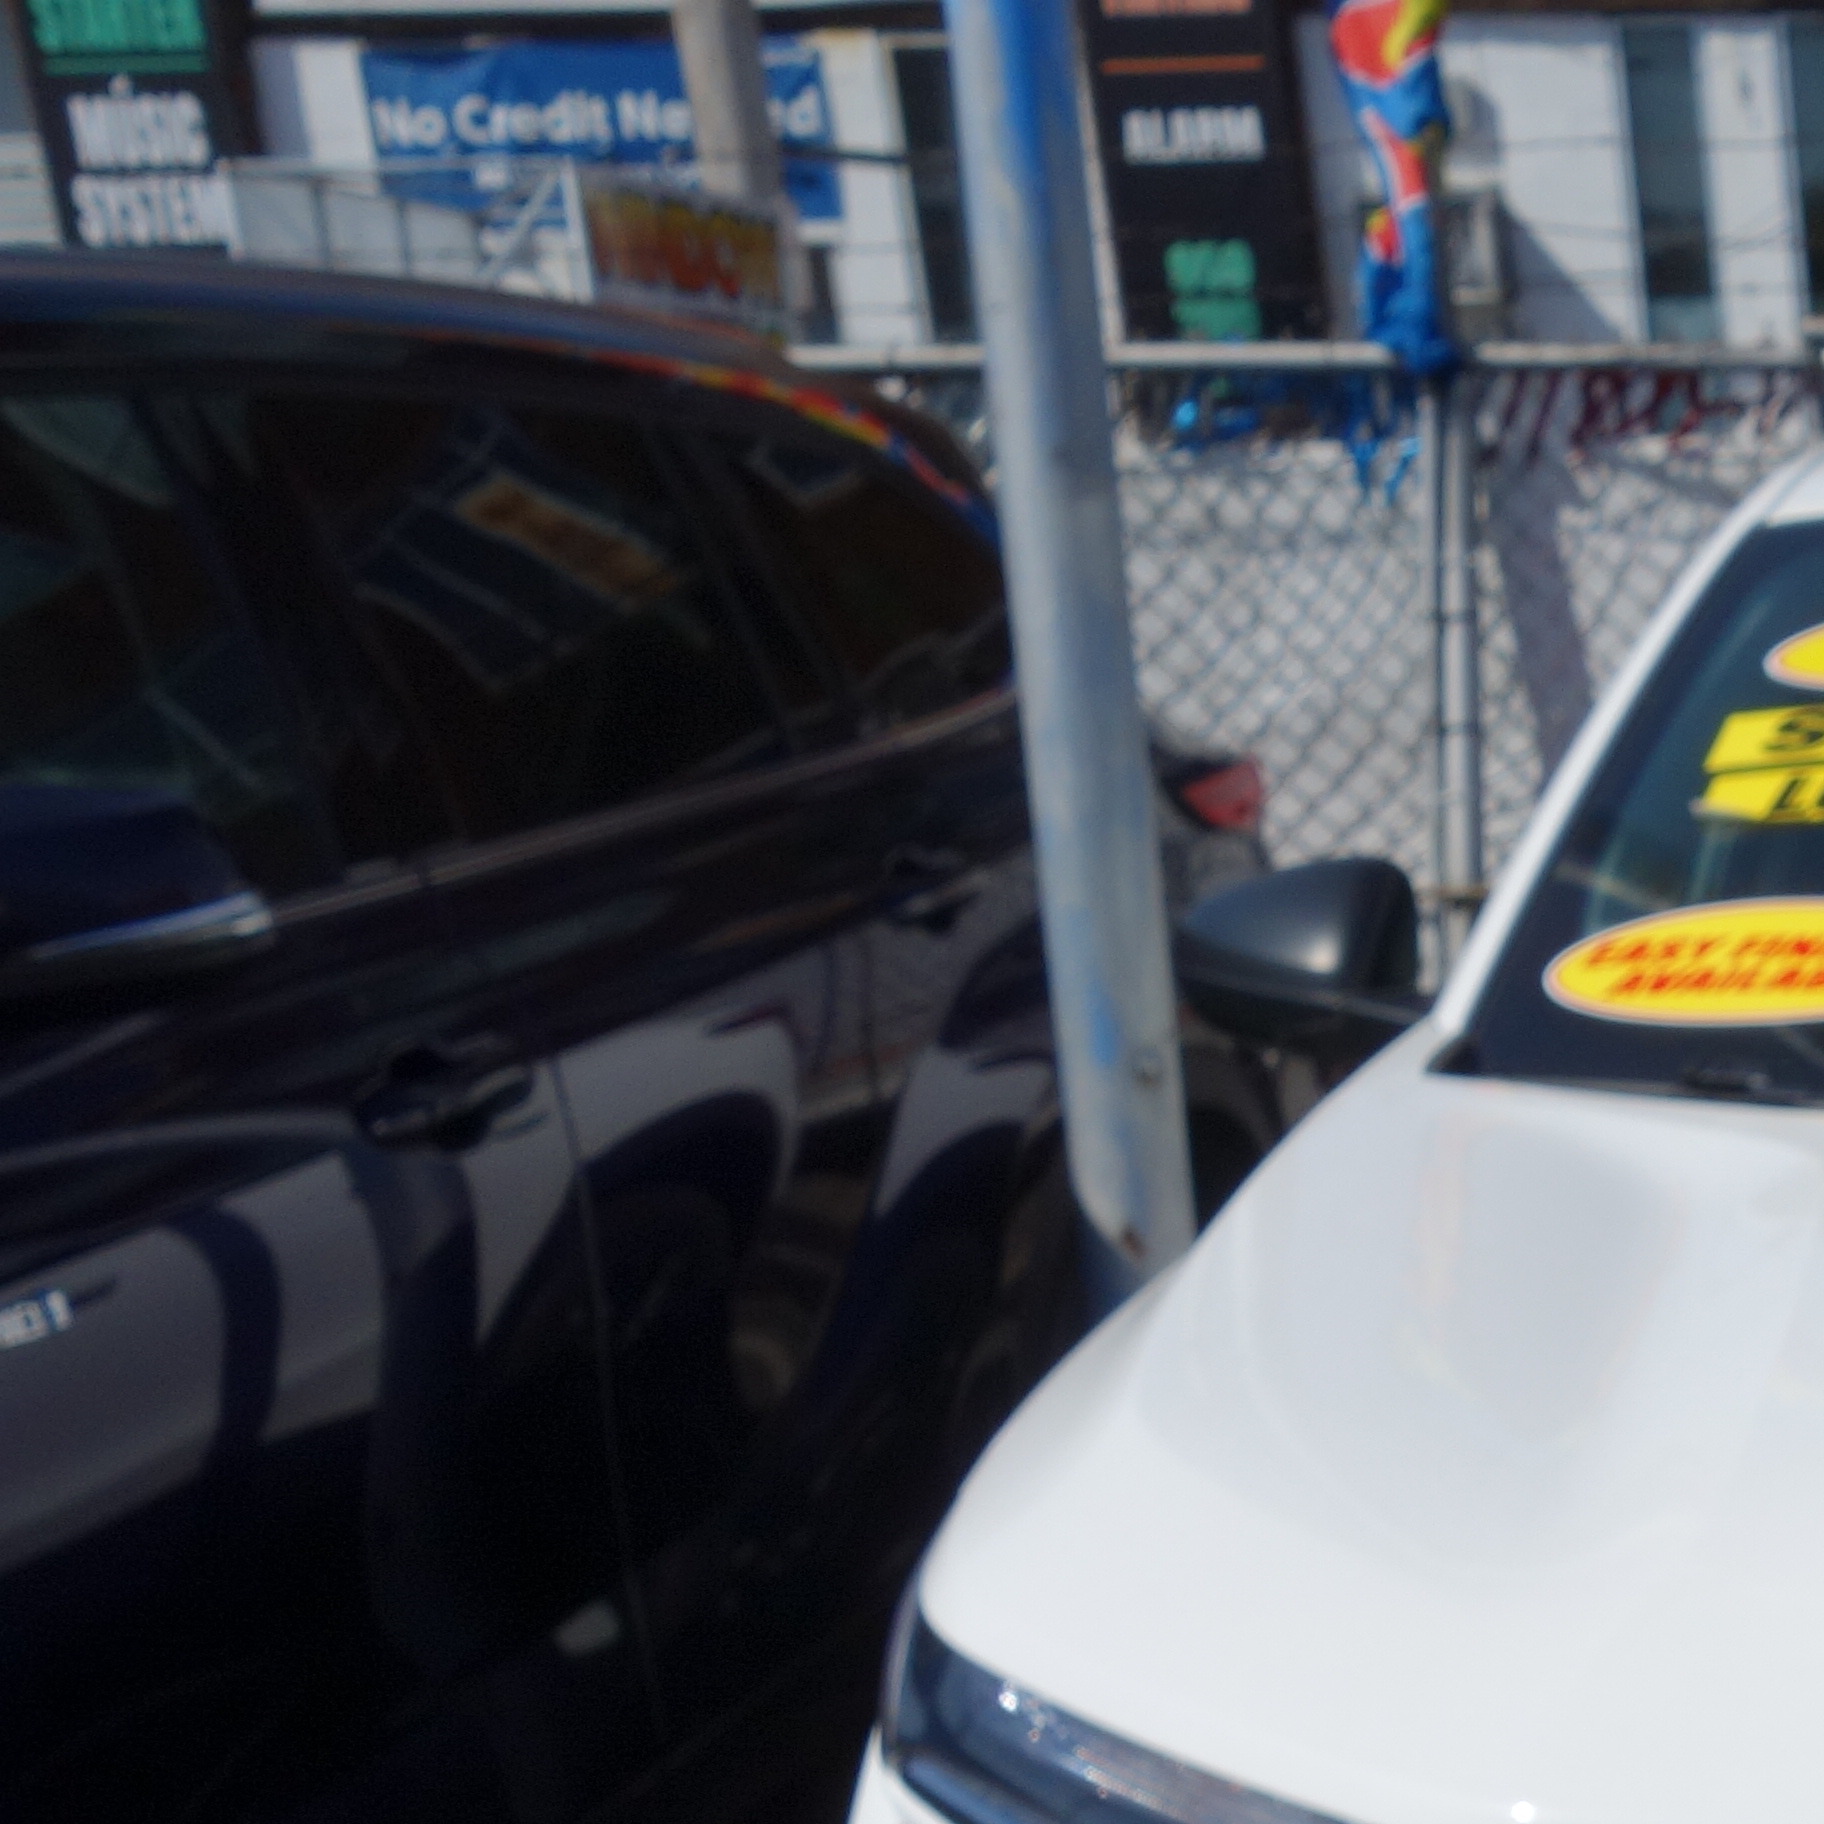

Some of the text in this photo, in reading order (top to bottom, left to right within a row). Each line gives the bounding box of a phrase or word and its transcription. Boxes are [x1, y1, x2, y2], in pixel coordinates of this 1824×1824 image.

[65, 91, 209, 168] MUSIC
[371, 88, 822, 152] No Credit Ned
[1121, 105, 1265, 165] ALARM
